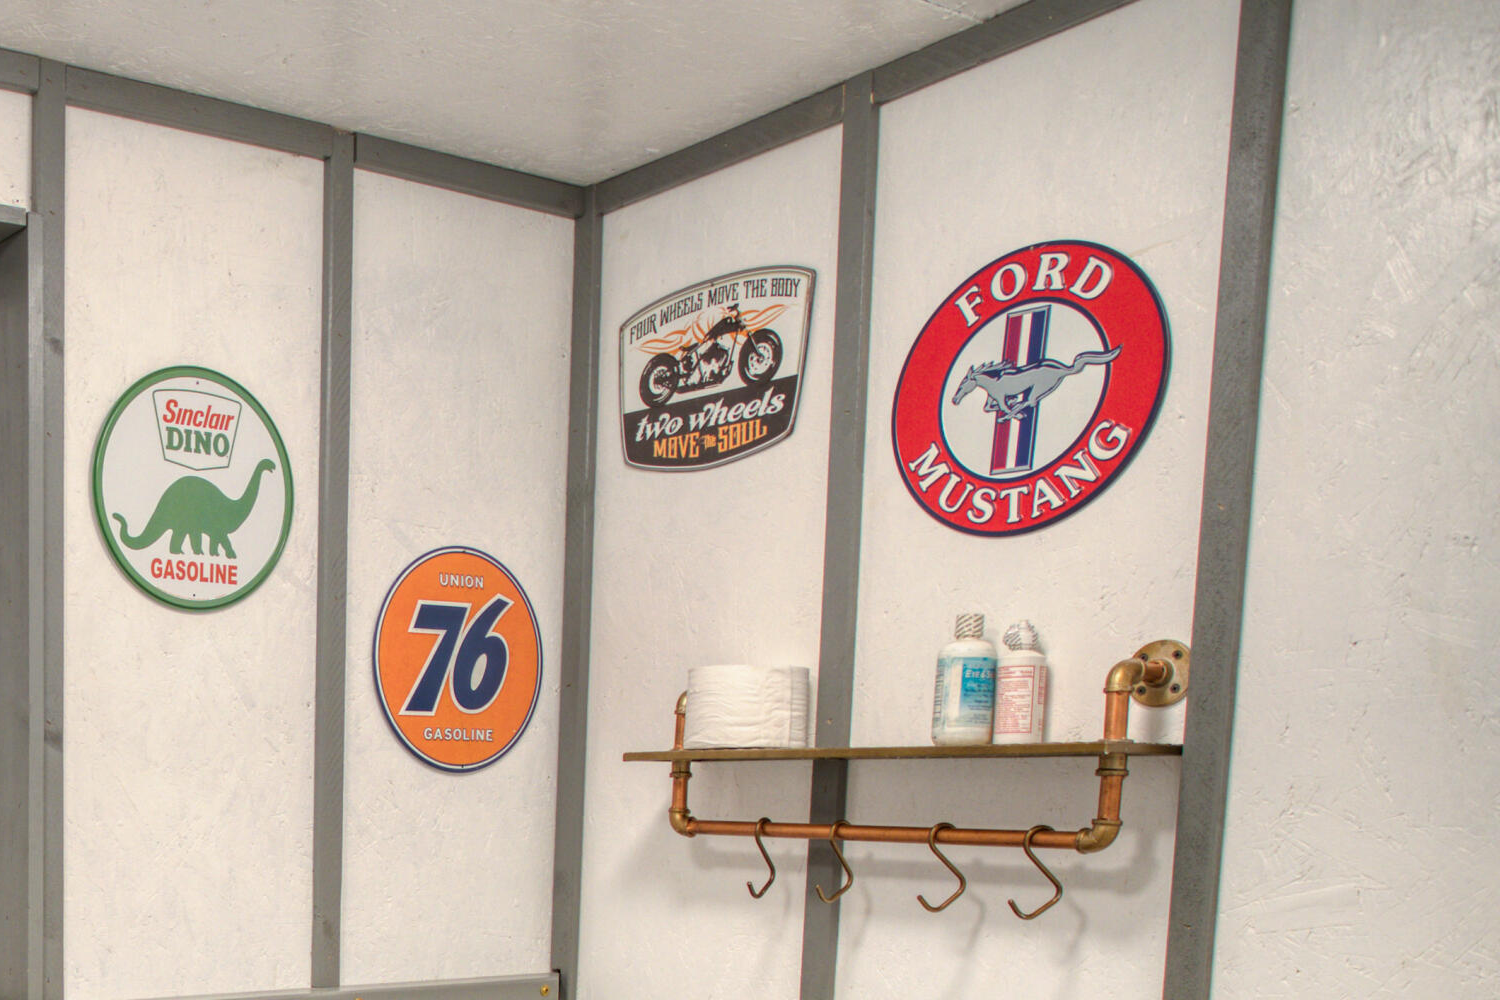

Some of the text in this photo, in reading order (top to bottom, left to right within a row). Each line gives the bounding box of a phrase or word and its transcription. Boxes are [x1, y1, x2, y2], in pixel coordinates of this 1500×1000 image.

[954, 252, 1114, 328] FORD
[629, 277, 801, 345] FOUR WHEELS MOVE THE BODY
[162, 398, 235, 431] Sinclair
[635, 386, 786, 442] two wheels
[165, 426, 230, 457] DINO
[653, 432, 700, 459] MOVE
[717, 418, 768, 453] SOUL
[907, 419, 1133, 525] MUSTANG
[150, 557, 238, 585] GASOLINE
[438, 573, 484, 589] UNION
[398, 593, 515, 717] 76
[423, 727, 494, 742] GASOLINE
